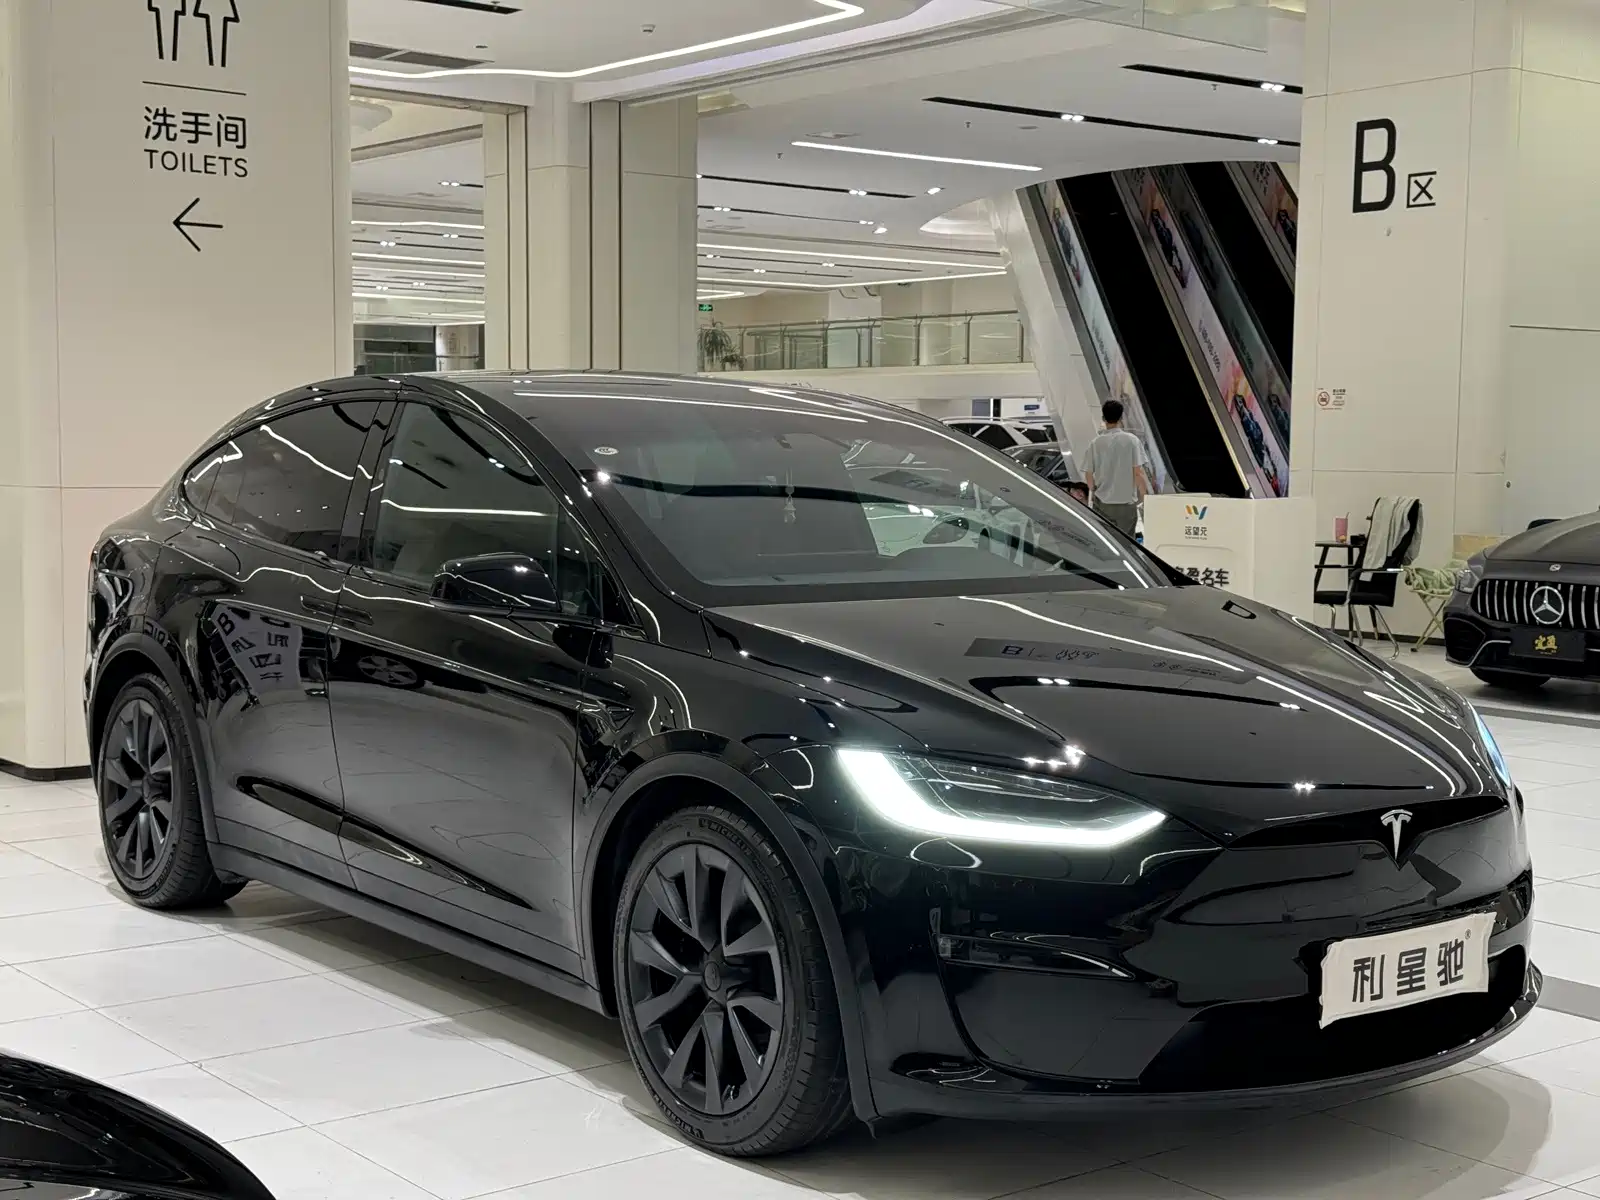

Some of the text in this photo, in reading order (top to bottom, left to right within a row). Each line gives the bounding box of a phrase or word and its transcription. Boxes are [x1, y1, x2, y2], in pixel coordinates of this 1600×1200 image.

[143, 106, 247, 149] 洗手间
[143, 148, 248, 178] TOILETS
[1352, 938, 1465, 1003] 利星驰
